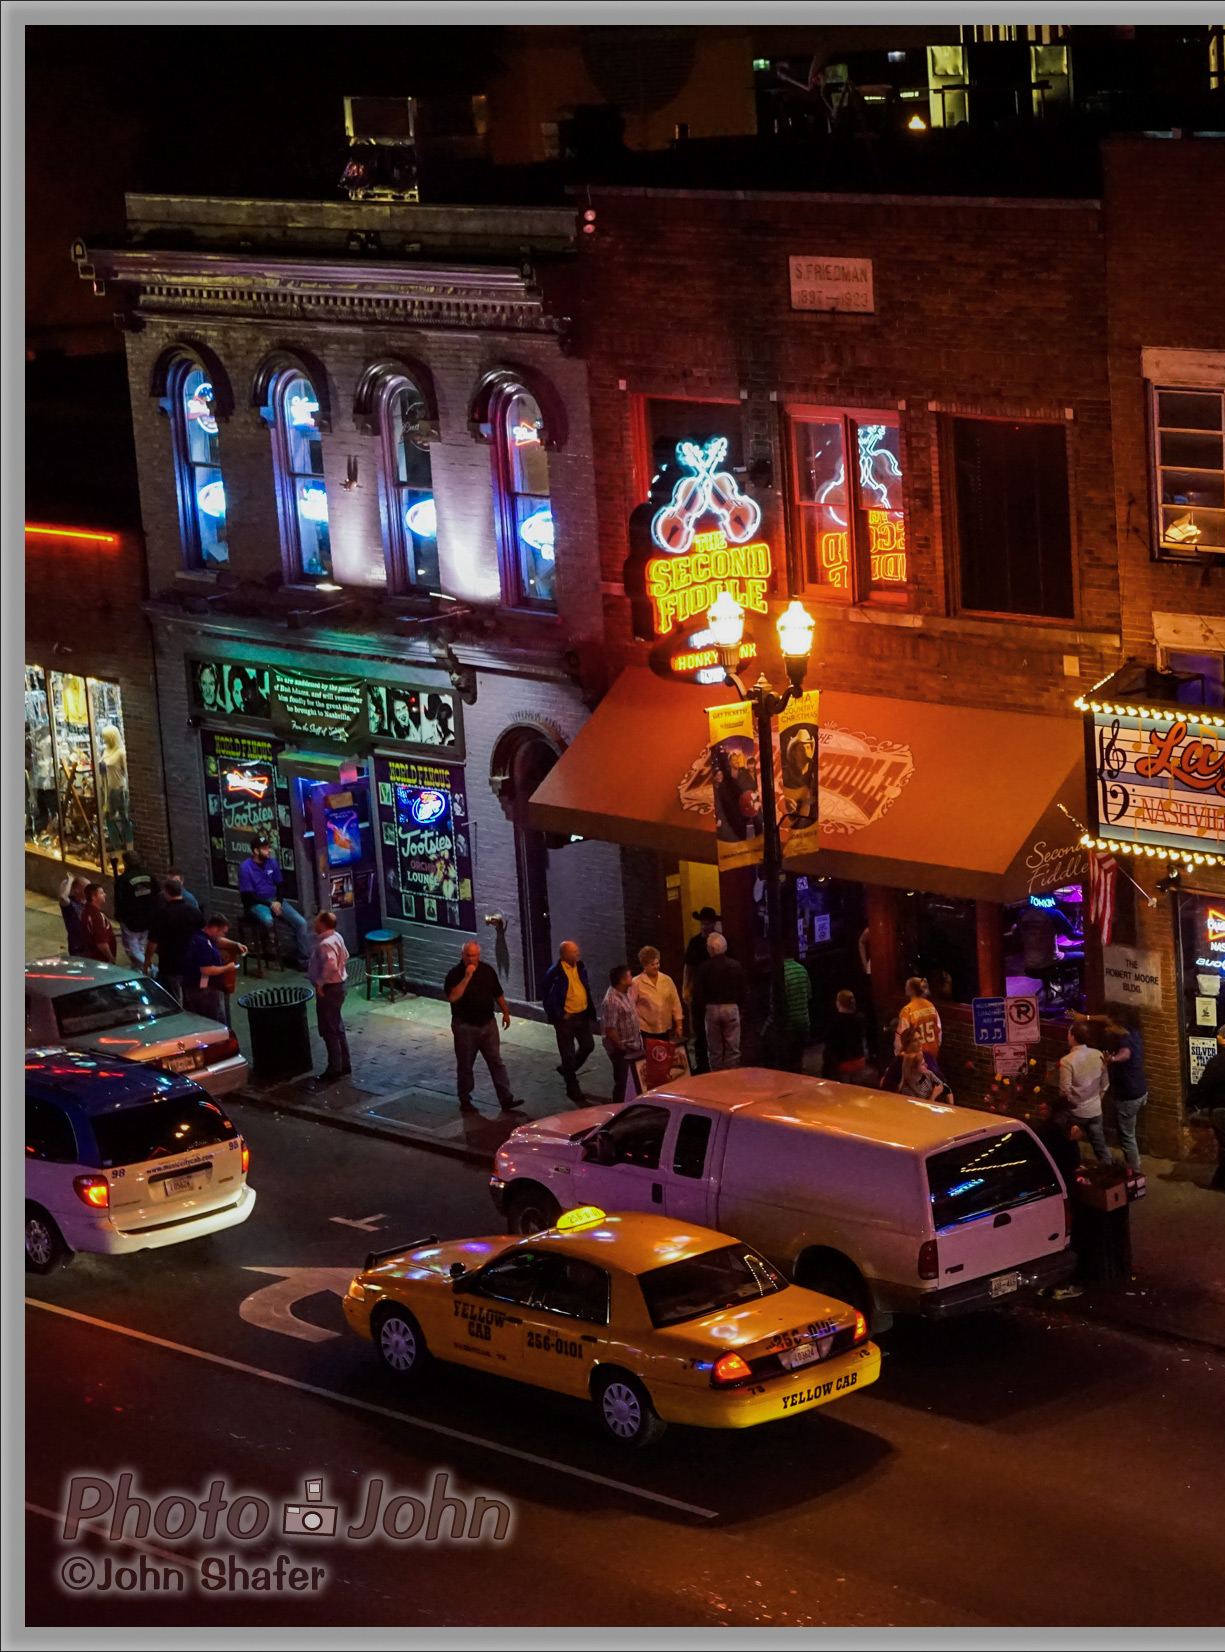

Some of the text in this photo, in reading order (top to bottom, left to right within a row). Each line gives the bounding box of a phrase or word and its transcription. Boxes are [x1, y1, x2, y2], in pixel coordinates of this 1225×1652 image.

[806, 264, 868, 283] FRIEDMAN
[695, 530, 728, 553] THE
[646, 543, 772, 597] SECOND
[655, 579, 769, 634] FIDDLE
[671, 649, 719, 671] HONKY
[294, 679, 321, 689] saddened
[321, 684, 329, 692] by
[338, 686, 360, 696] passing
[278, 694, 288, 702] him
[289, 696, 306, 706] fondly
[315, 700, 325, 708] the
[342, 704, 360, 714] things
[323, 692, 334, 701] will
[334, 695, 363, 705] remember
[294, 706, 317, 717] brought
[712, 711, 724, 720] GET
[780, 711, 818, 724] CHRISTMAS
[783, 704, 815, 716] COUNTRY
[214, 735, 273, 761] WORLD FAMOUS
[388, 761, 451, 790] WORLD FAMOUS
[223, 798, 274, 829] Tootsies
[398, 825, 453, 858] Tootsies
[1027, 854, 1090, 894] Fiddle
[1125, 959, 1138, 970] THE
[1196, 958, 1223, 968] BUD
[1105, 967, 1159, 986] ROBERT MOORE
[1122, 983, 1142, 994] BLDG.
[918, 1020, 936, 1044] 15
[1191, 1046, 1217, 1056] SILVER
[228, 1140, 239, 1150] 98
[112, 1168, 126, 1179] 98
[453, 1300, 507, 1328] YELLOW
[468, 1320, 491, 1341] CAB
[527, 1332, 583, 1359] 256-0101
[782, 1372, 858, 1410] YELLOW CAB
